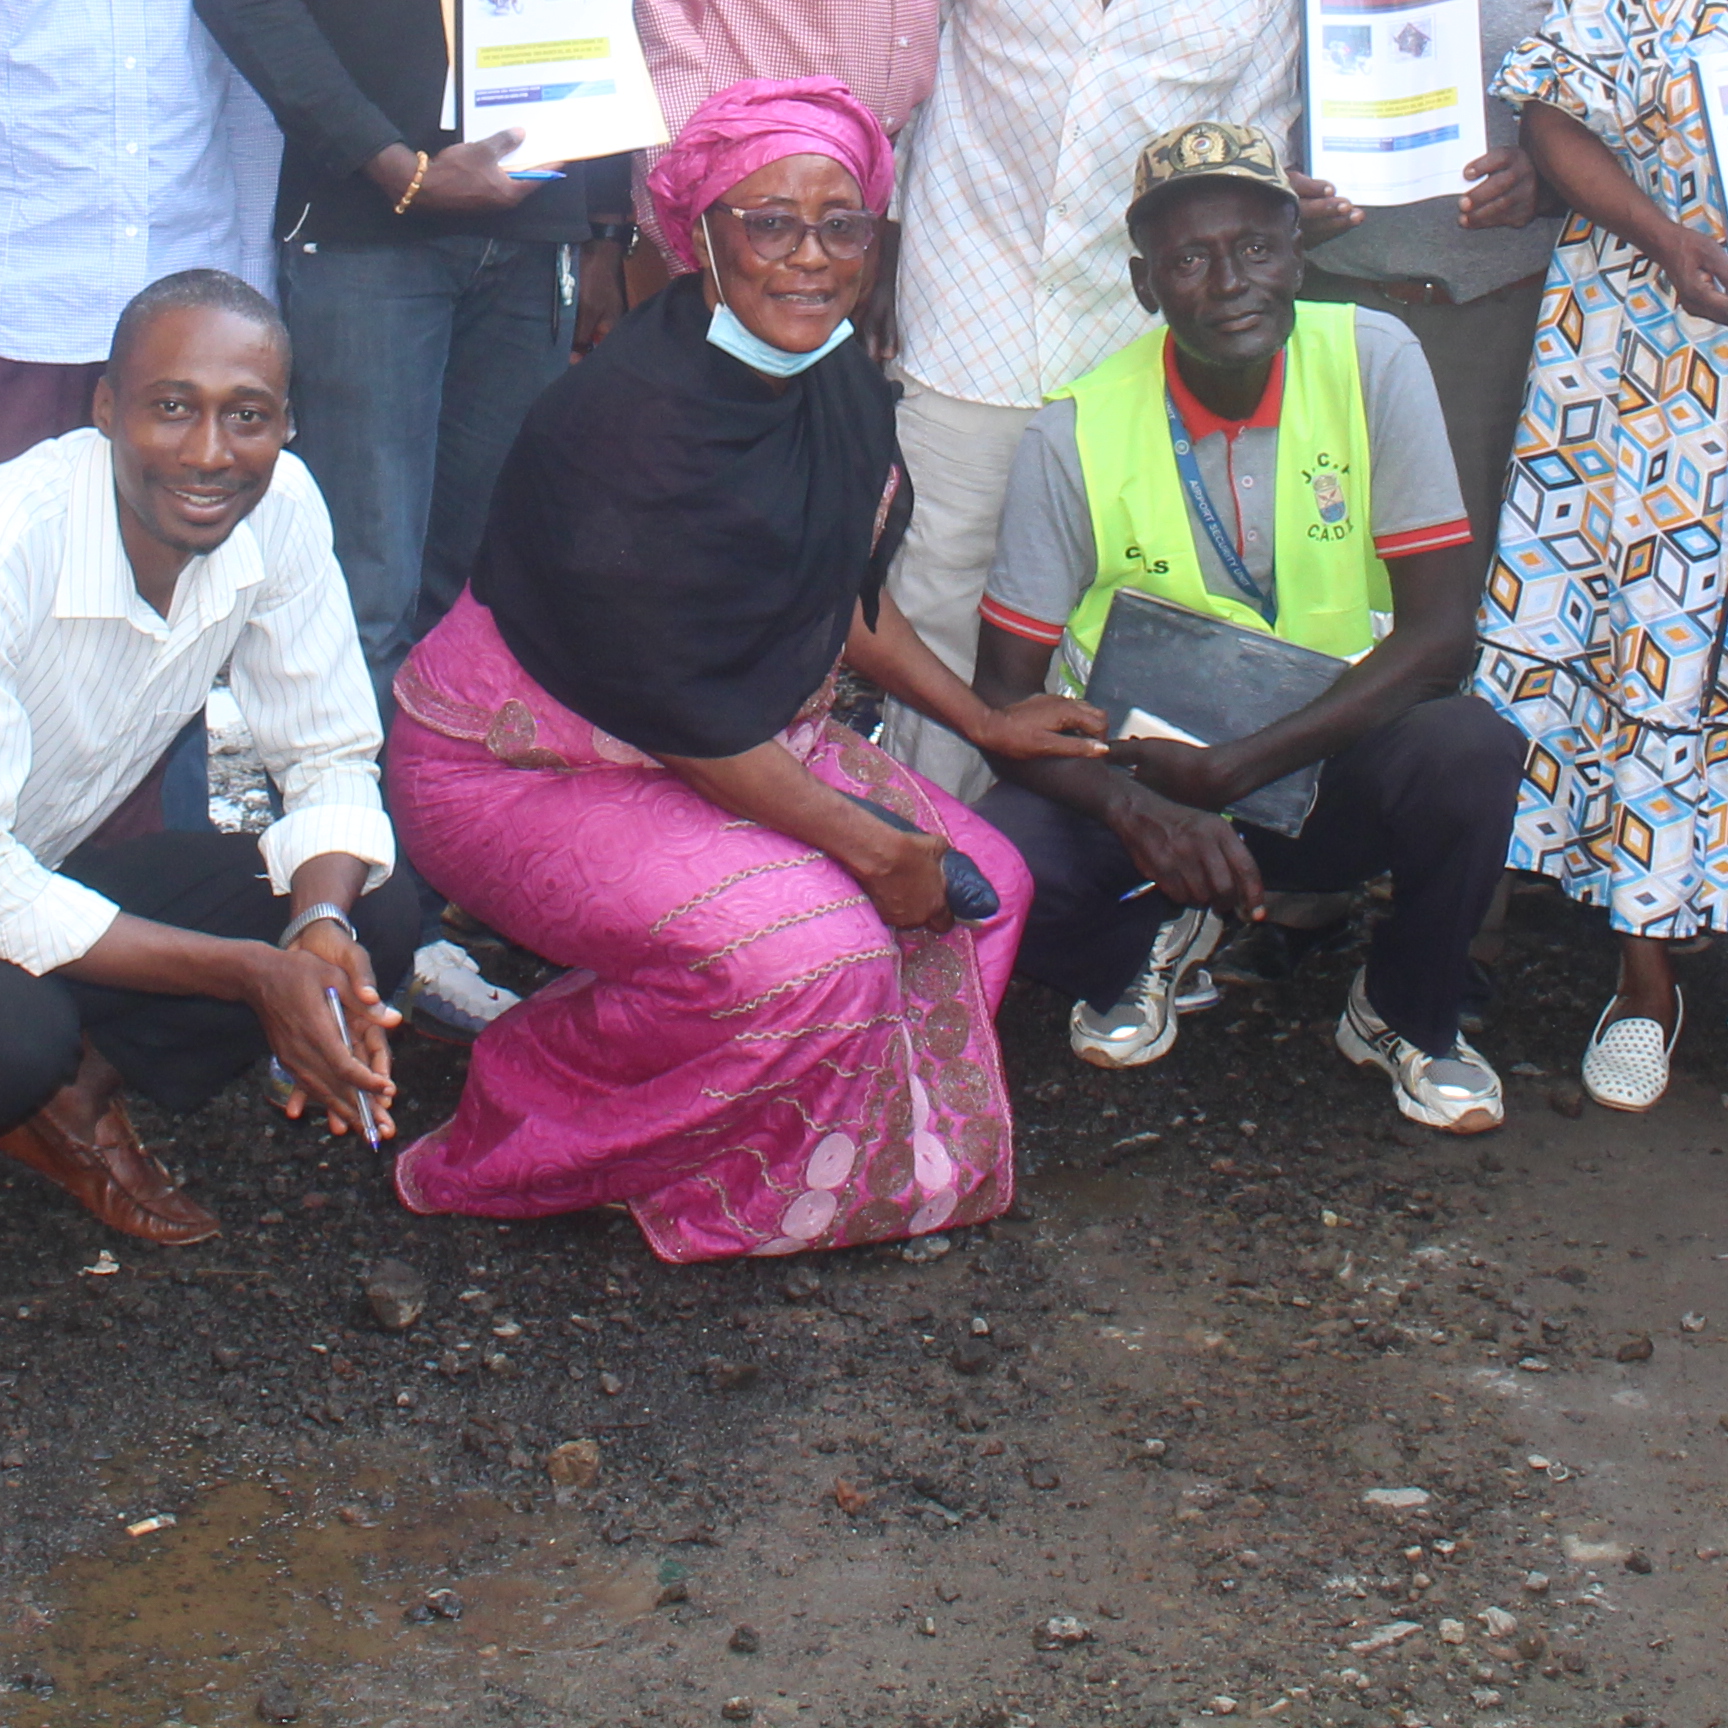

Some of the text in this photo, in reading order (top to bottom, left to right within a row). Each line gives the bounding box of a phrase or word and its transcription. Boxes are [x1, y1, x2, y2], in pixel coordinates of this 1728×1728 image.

[1189, 479, 1251, 588] AIRPORT SECURITY UNIT
